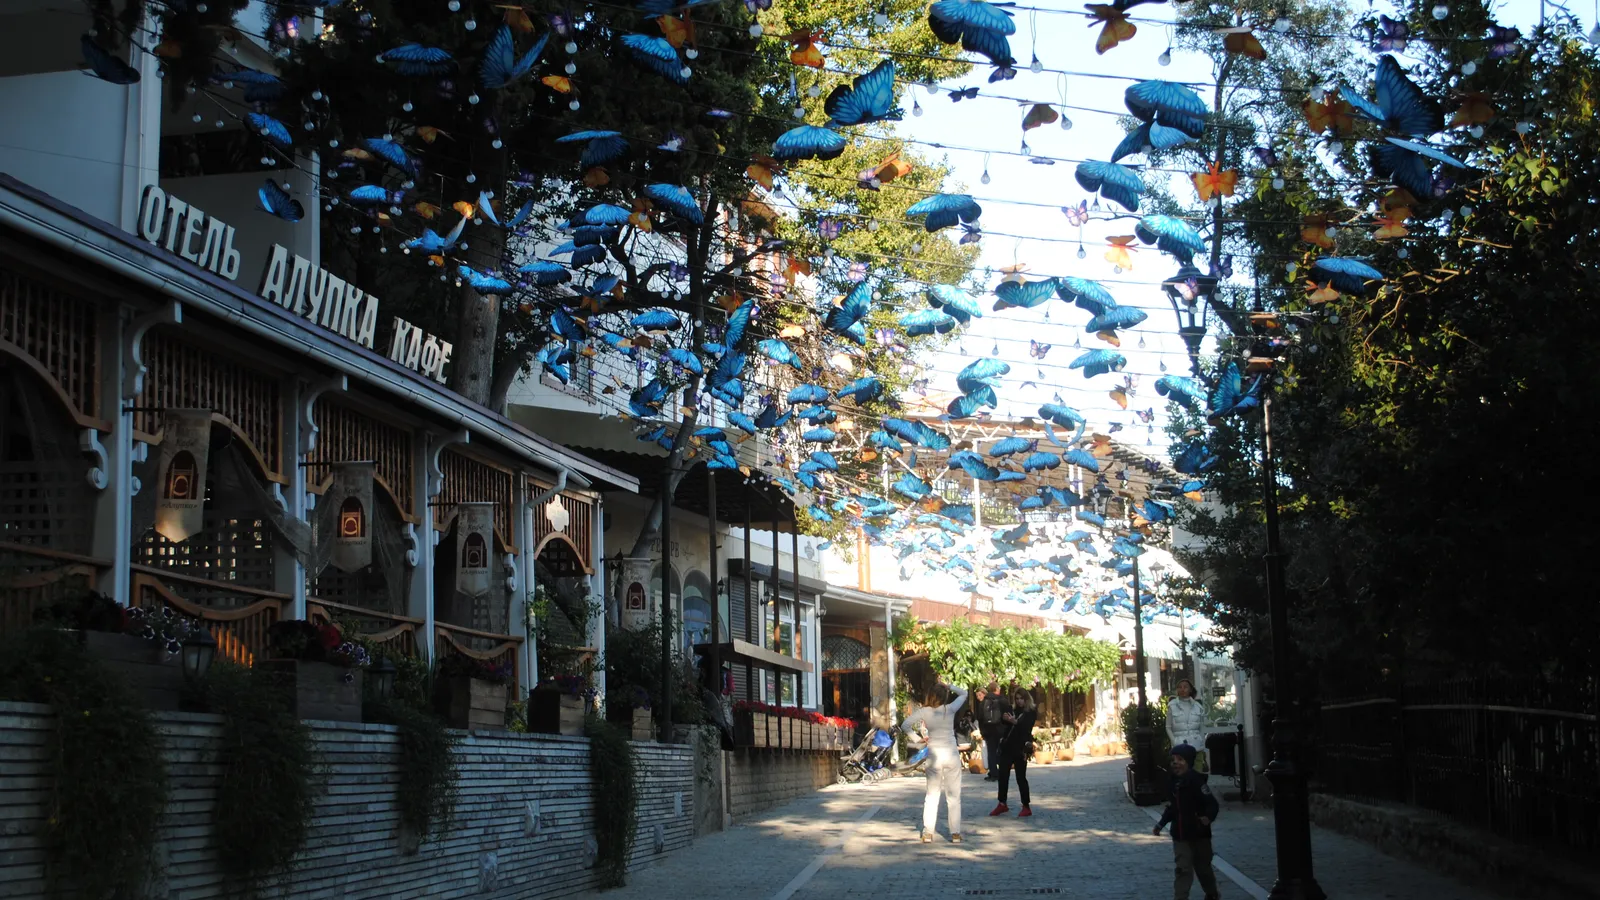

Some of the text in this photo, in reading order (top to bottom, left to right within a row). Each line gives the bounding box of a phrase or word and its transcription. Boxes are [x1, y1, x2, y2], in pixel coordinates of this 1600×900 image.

[141, 185, 454, 384] ОТЕЛЬ АЛУПКА КАФЕ
